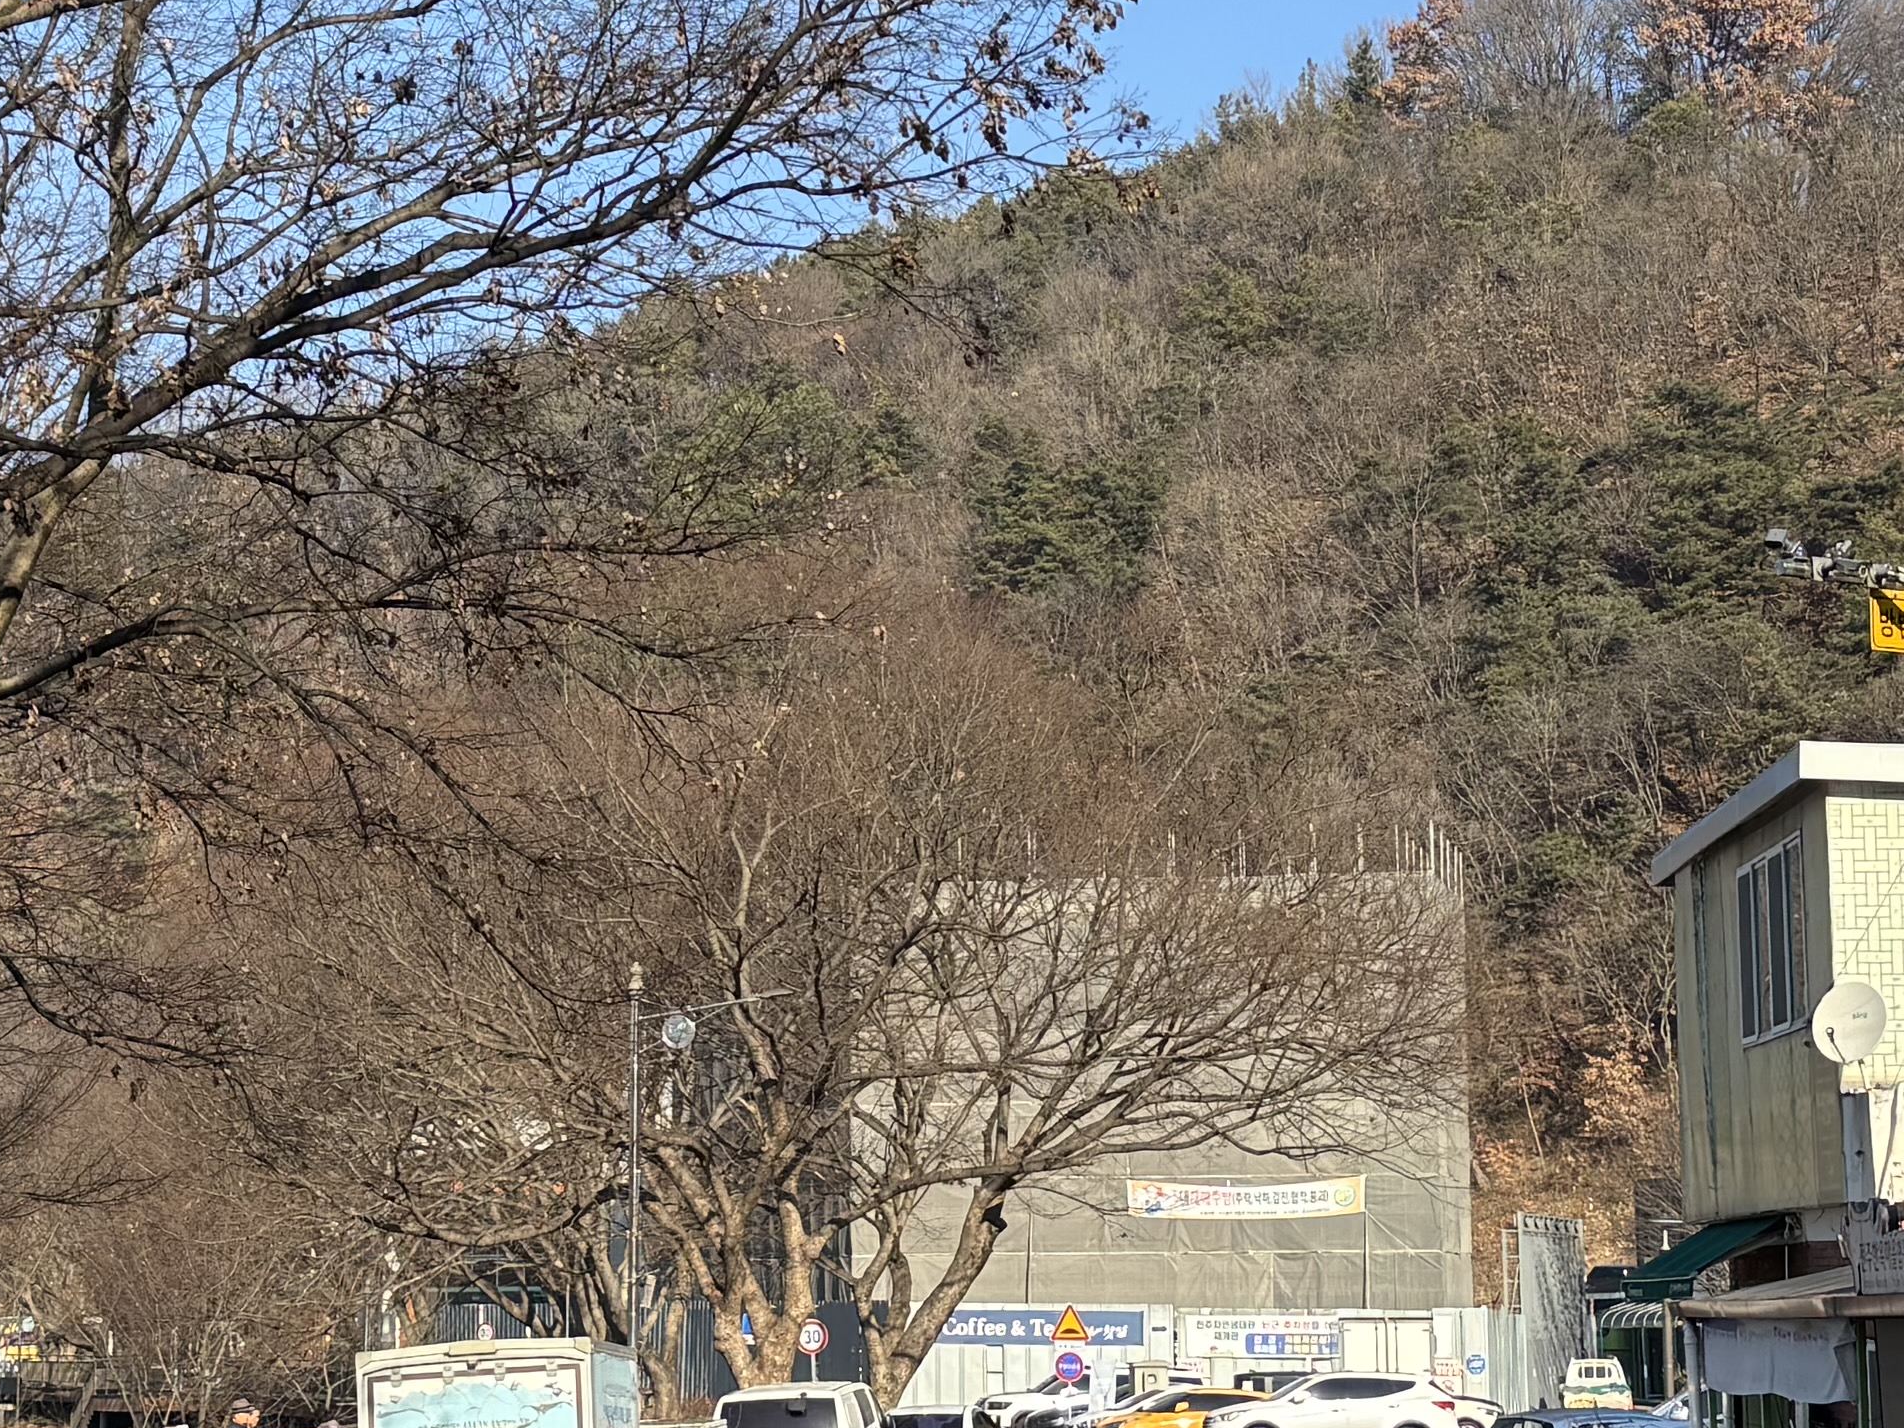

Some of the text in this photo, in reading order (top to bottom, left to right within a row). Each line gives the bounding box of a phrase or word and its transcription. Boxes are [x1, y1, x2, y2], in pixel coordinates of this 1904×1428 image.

[942, 1317, 1055, 1337] Coffee & Te
[804, 1329, 821, 1344] 30
